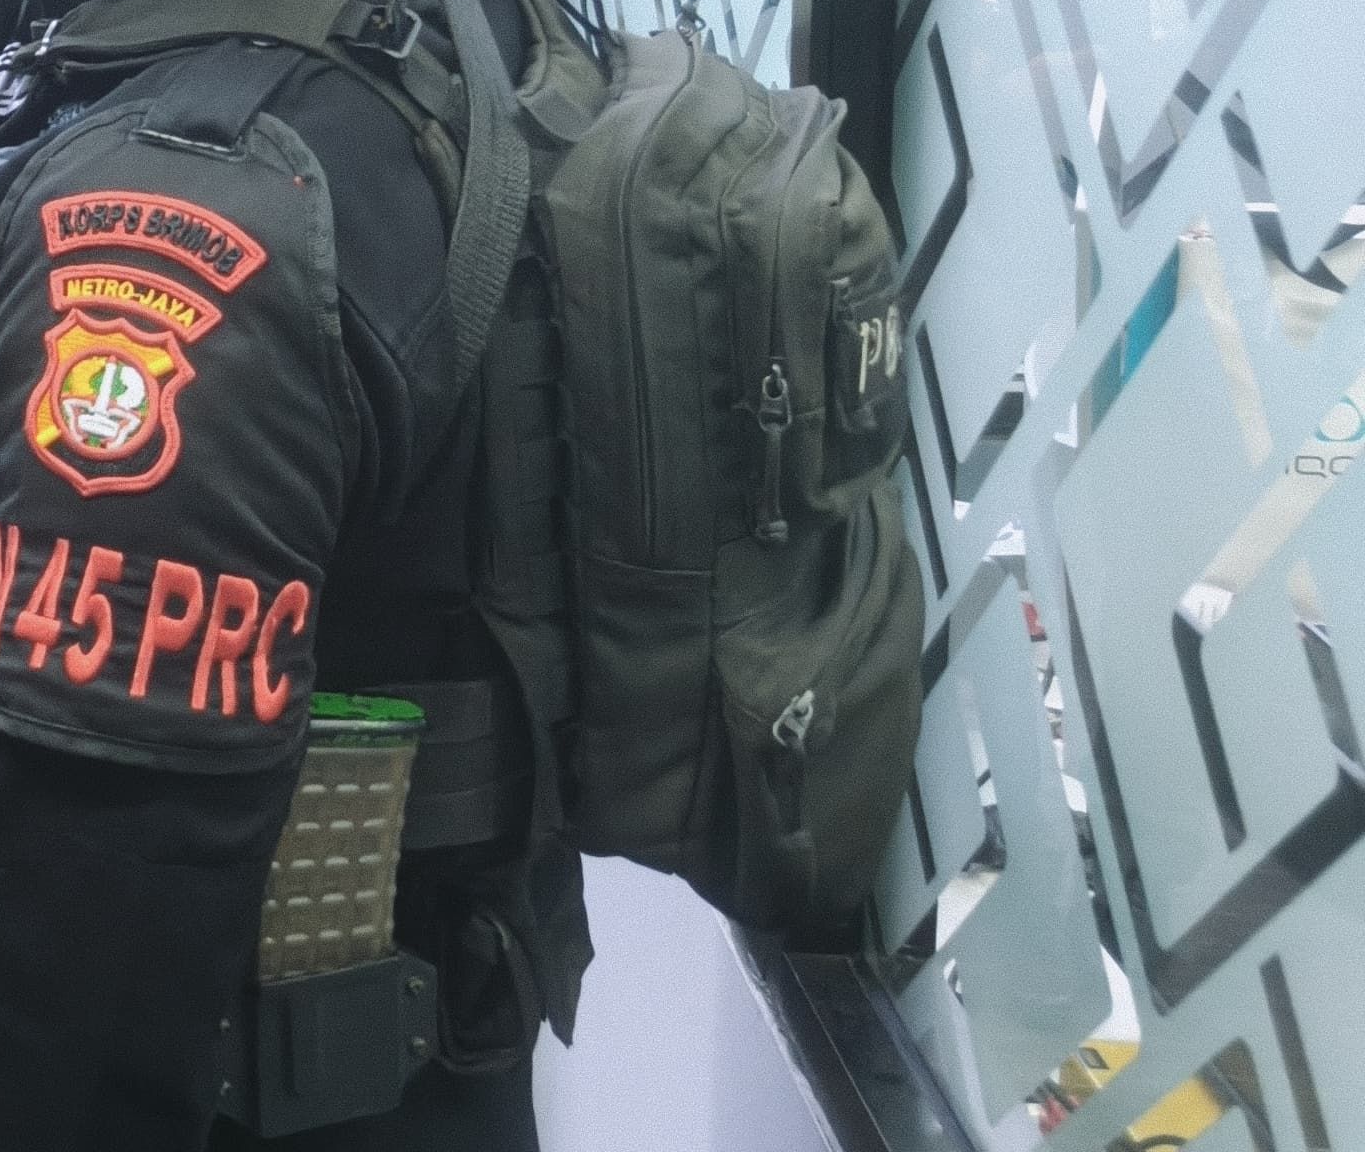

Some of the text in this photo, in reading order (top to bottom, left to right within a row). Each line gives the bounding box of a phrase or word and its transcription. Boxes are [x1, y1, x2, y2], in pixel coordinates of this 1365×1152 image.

[58, 204, 243, 275] KORPS BRIMOB
[66, 278, 195, 328] METRO-JAYA
[15, 537, 123, 686] 45
[130, 559, 310, 723] PRC
